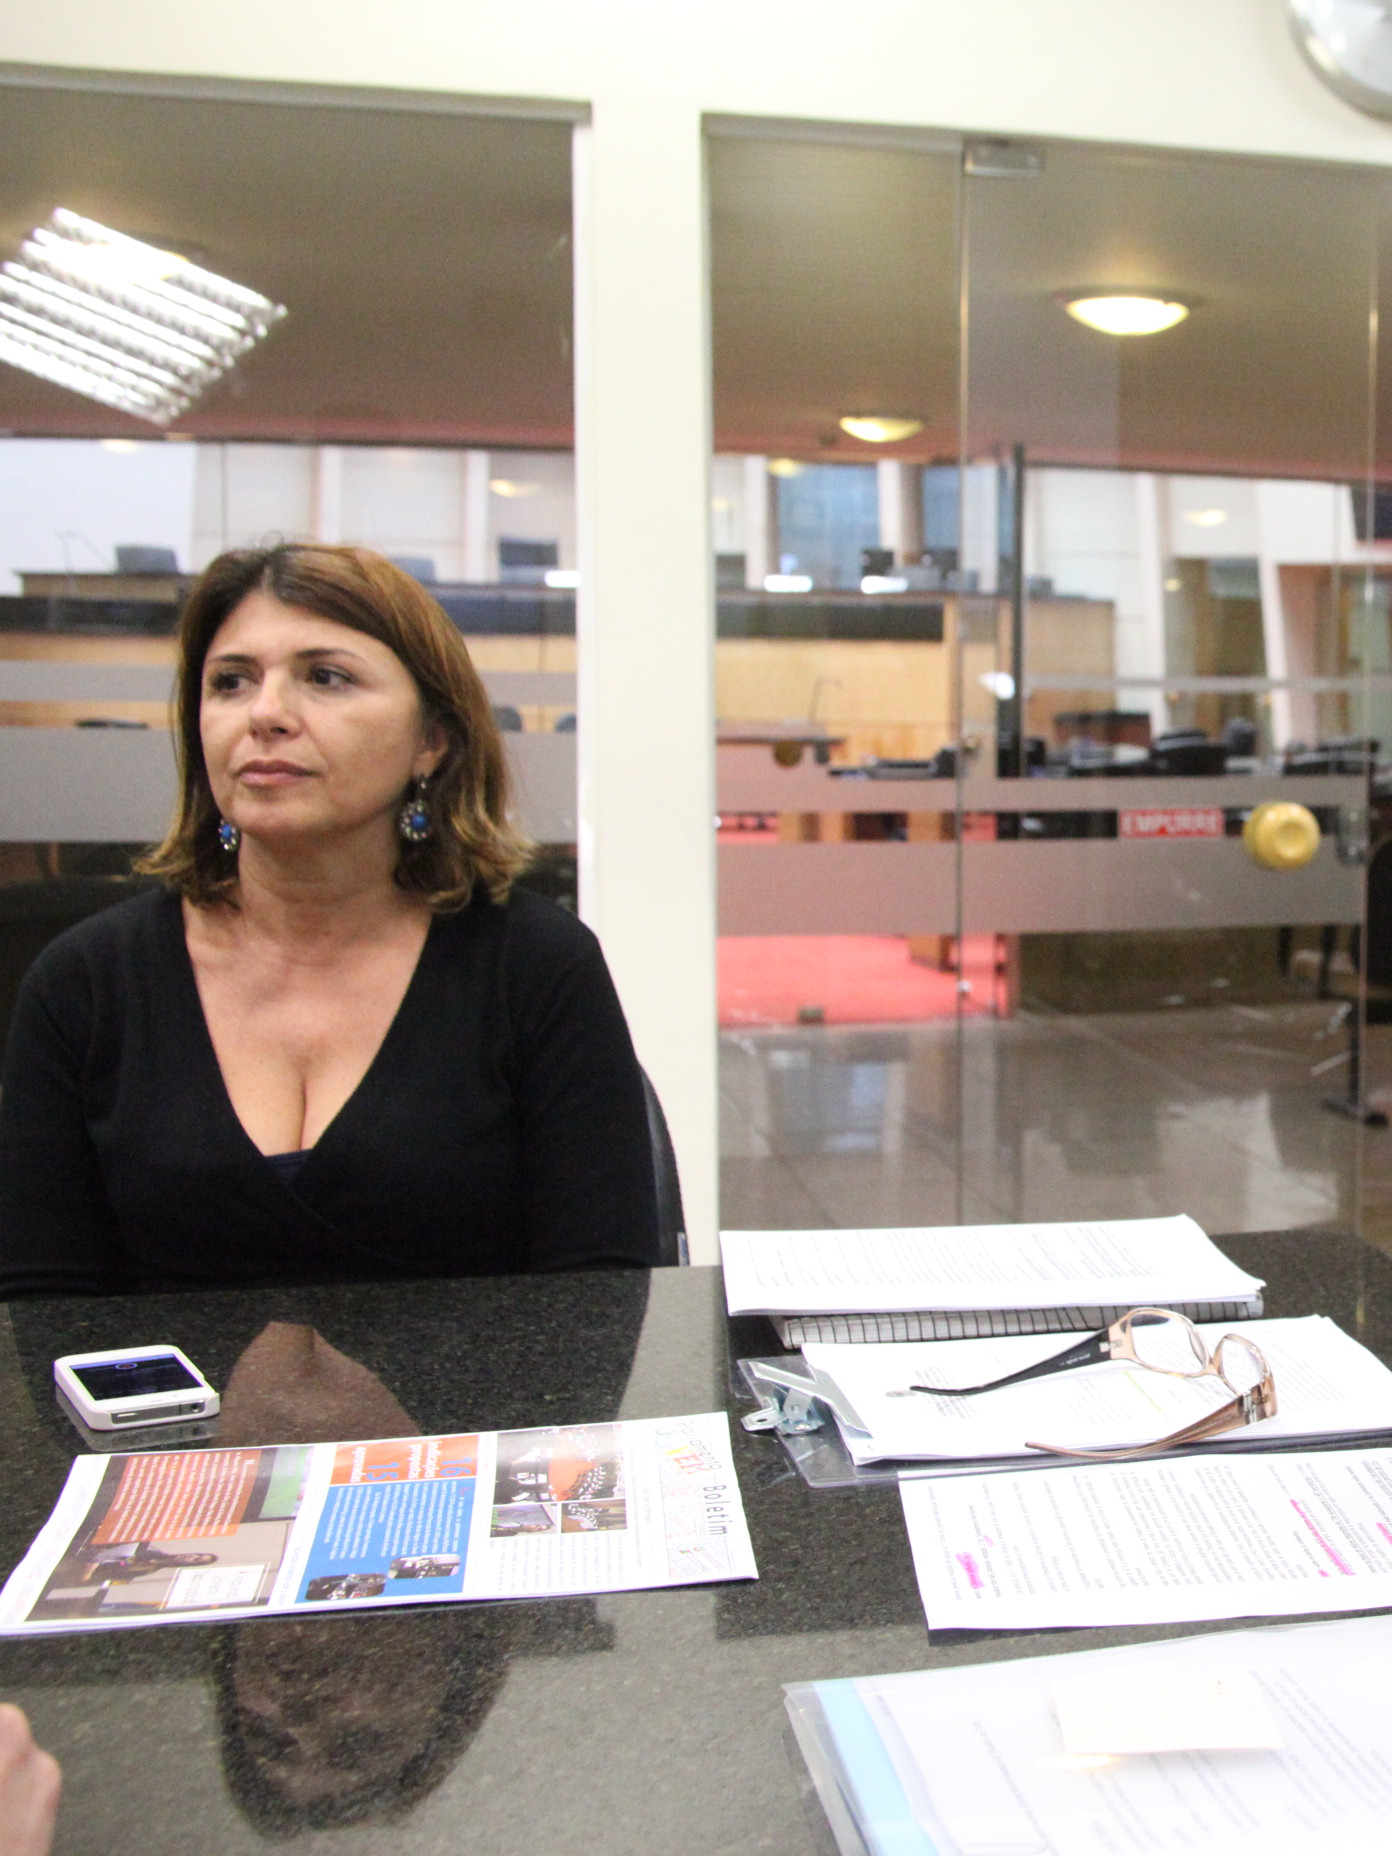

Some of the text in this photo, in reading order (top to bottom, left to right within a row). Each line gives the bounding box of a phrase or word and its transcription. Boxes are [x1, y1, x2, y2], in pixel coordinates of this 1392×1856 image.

[408, 1444, 423, 1480] propostas
[424, 1441, 443, 1478] indicações
[677, 1420, 722, 1470] Parlamento
[350, 1446, 367, 1483] aprovadas
[366, 1461, 400, 1481] 15
[439, 1457, 472, 1477] 16
[702, 1485, 734, 1536] Boletim
